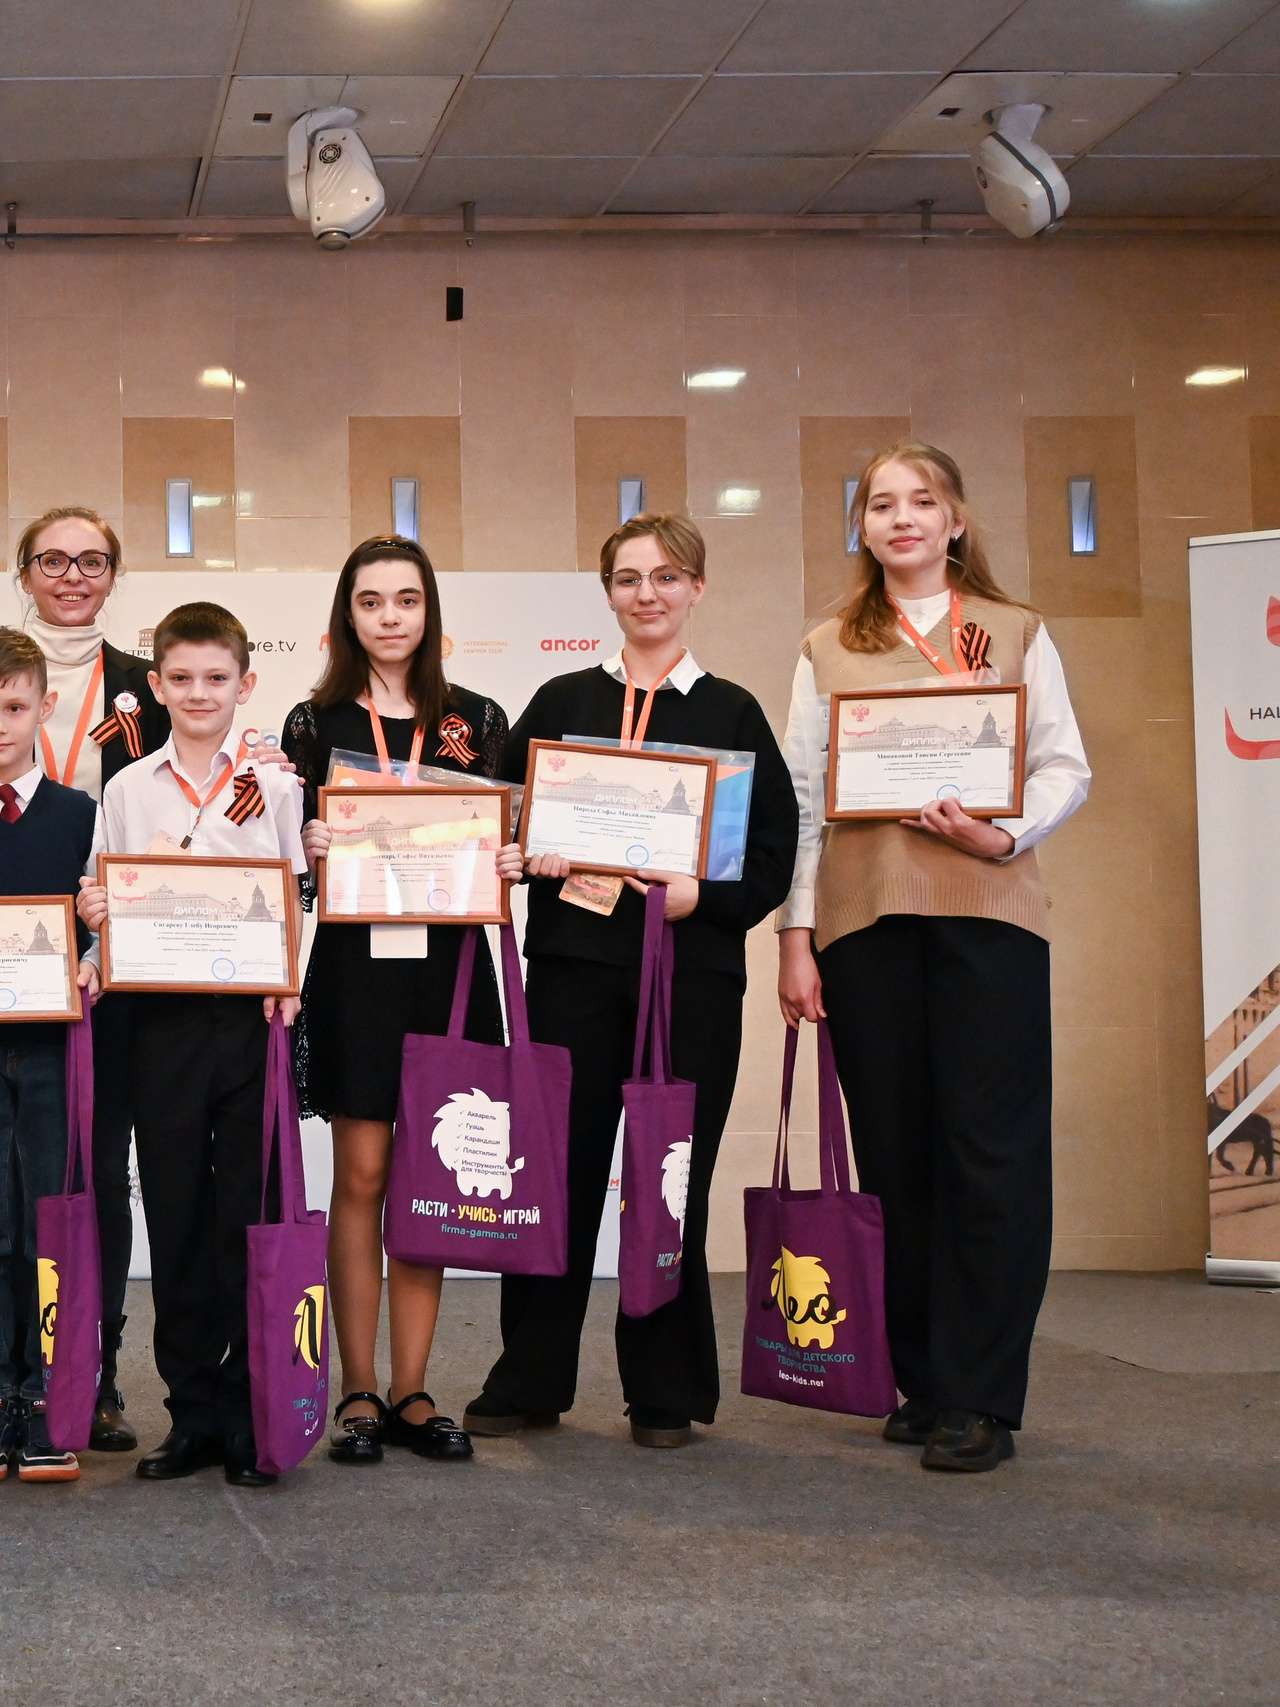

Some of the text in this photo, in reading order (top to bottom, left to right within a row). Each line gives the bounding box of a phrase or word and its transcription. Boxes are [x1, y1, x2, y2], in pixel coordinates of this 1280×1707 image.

[540, 639, 601, 652] ancor
[593, 793, 638, 805] ДИПЛОМ
[173, 906, 218, 916] ДИПЛОМ
[466, 1110, 497, 1121] Акварель
[465, 1123, 485, 1132] Гуашь
[463, 1134, 501, 1145] Карандаши
[462, 1147, 498, 1158] Пластилин
[461, 1159, 505, 1171] Инструменты
[411, 1198, 541, 1225] РАСТИ УЧИСЬ ИГРАЙ
[440, 1223, 518, 1241] firma-gamma.ru
[755, 1335, 788, 1352] ТОВАРЫ
[802, 1347, 856, 1364] ДЕТСКОГО
[777, 1353, 827, 1374] ТВОРЧЕСТВА
[778, 1369, 825, 1388] leo-kids.net
